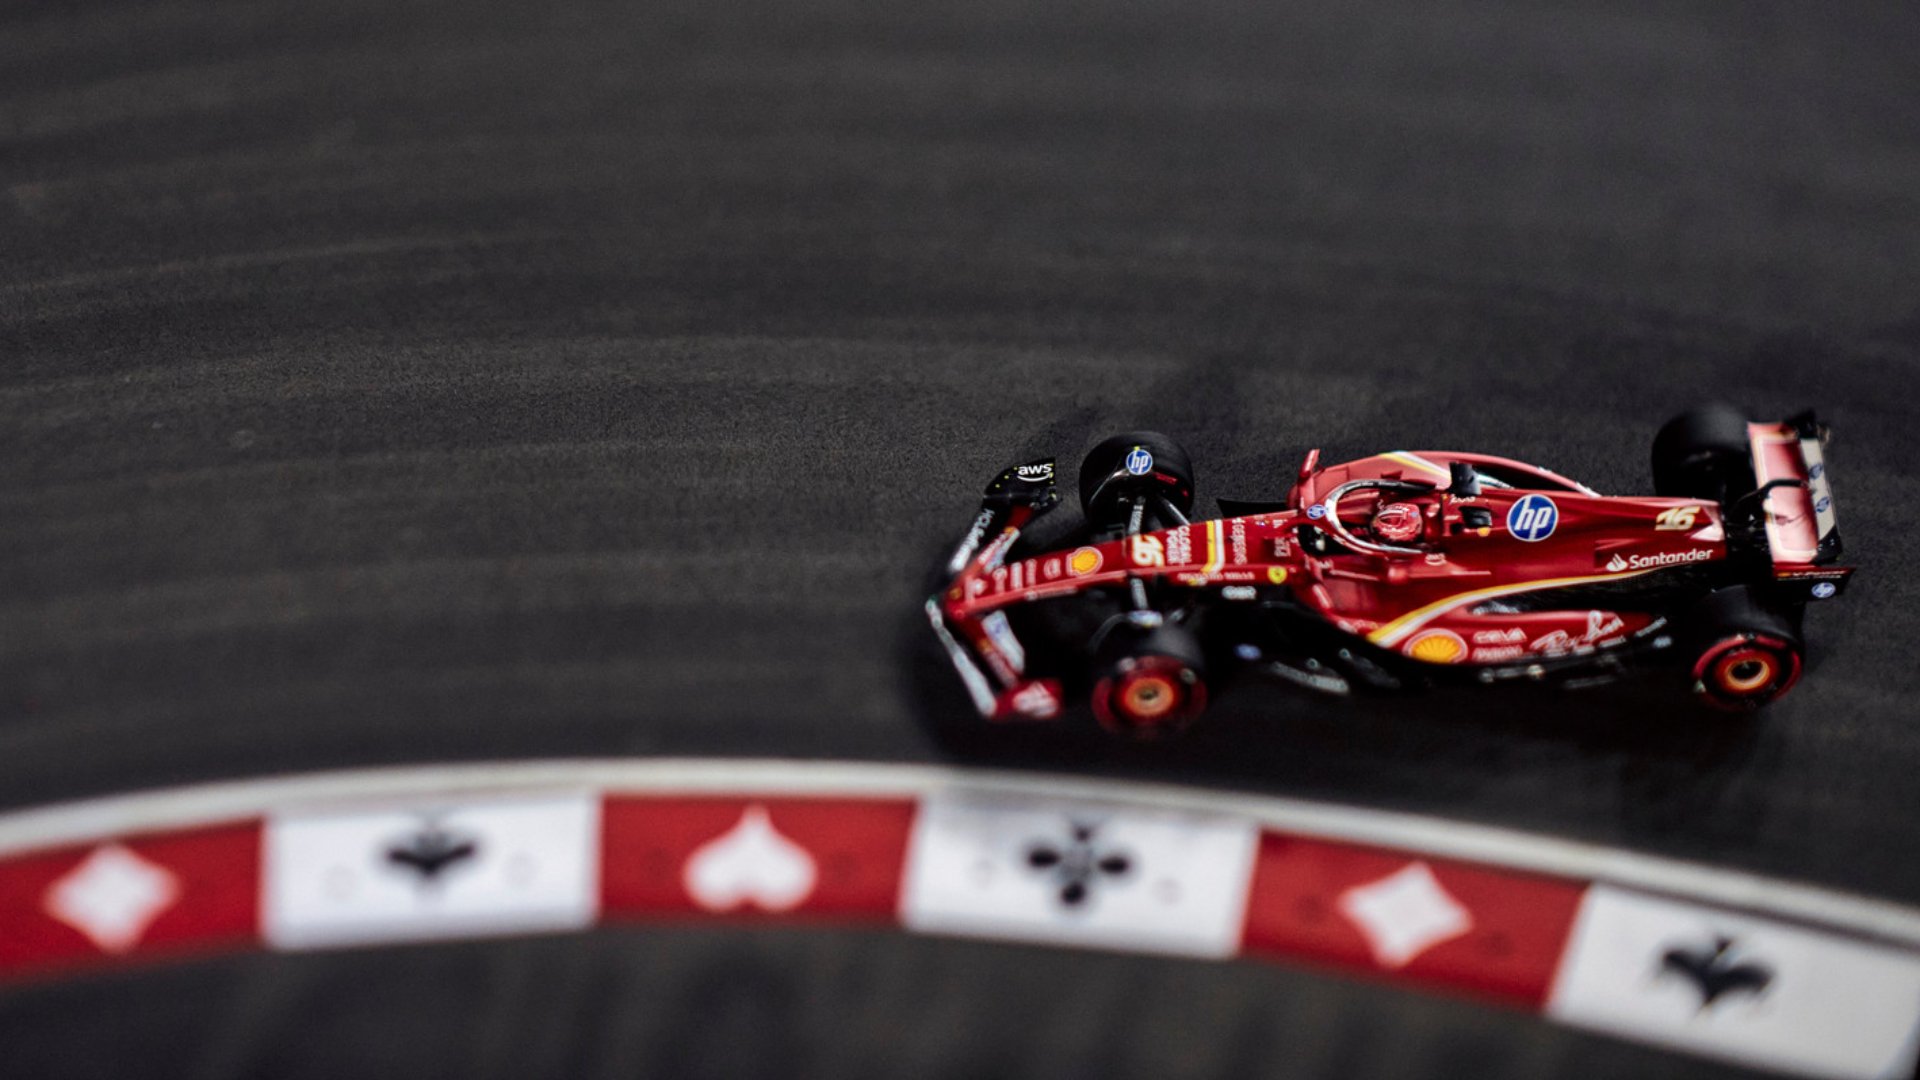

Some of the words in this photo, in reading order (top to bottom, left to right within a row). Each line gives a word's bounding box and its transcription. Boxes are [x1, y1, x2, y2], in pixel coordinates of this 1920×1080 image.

[1017, 462, 1053, 481] aws
[1130, 450, 1149, 475] hp
[1514, 494, 1552, 540] hp
[1655, 506, 1701, 531] 16
[1629, 547, 1714, 570] Santander
